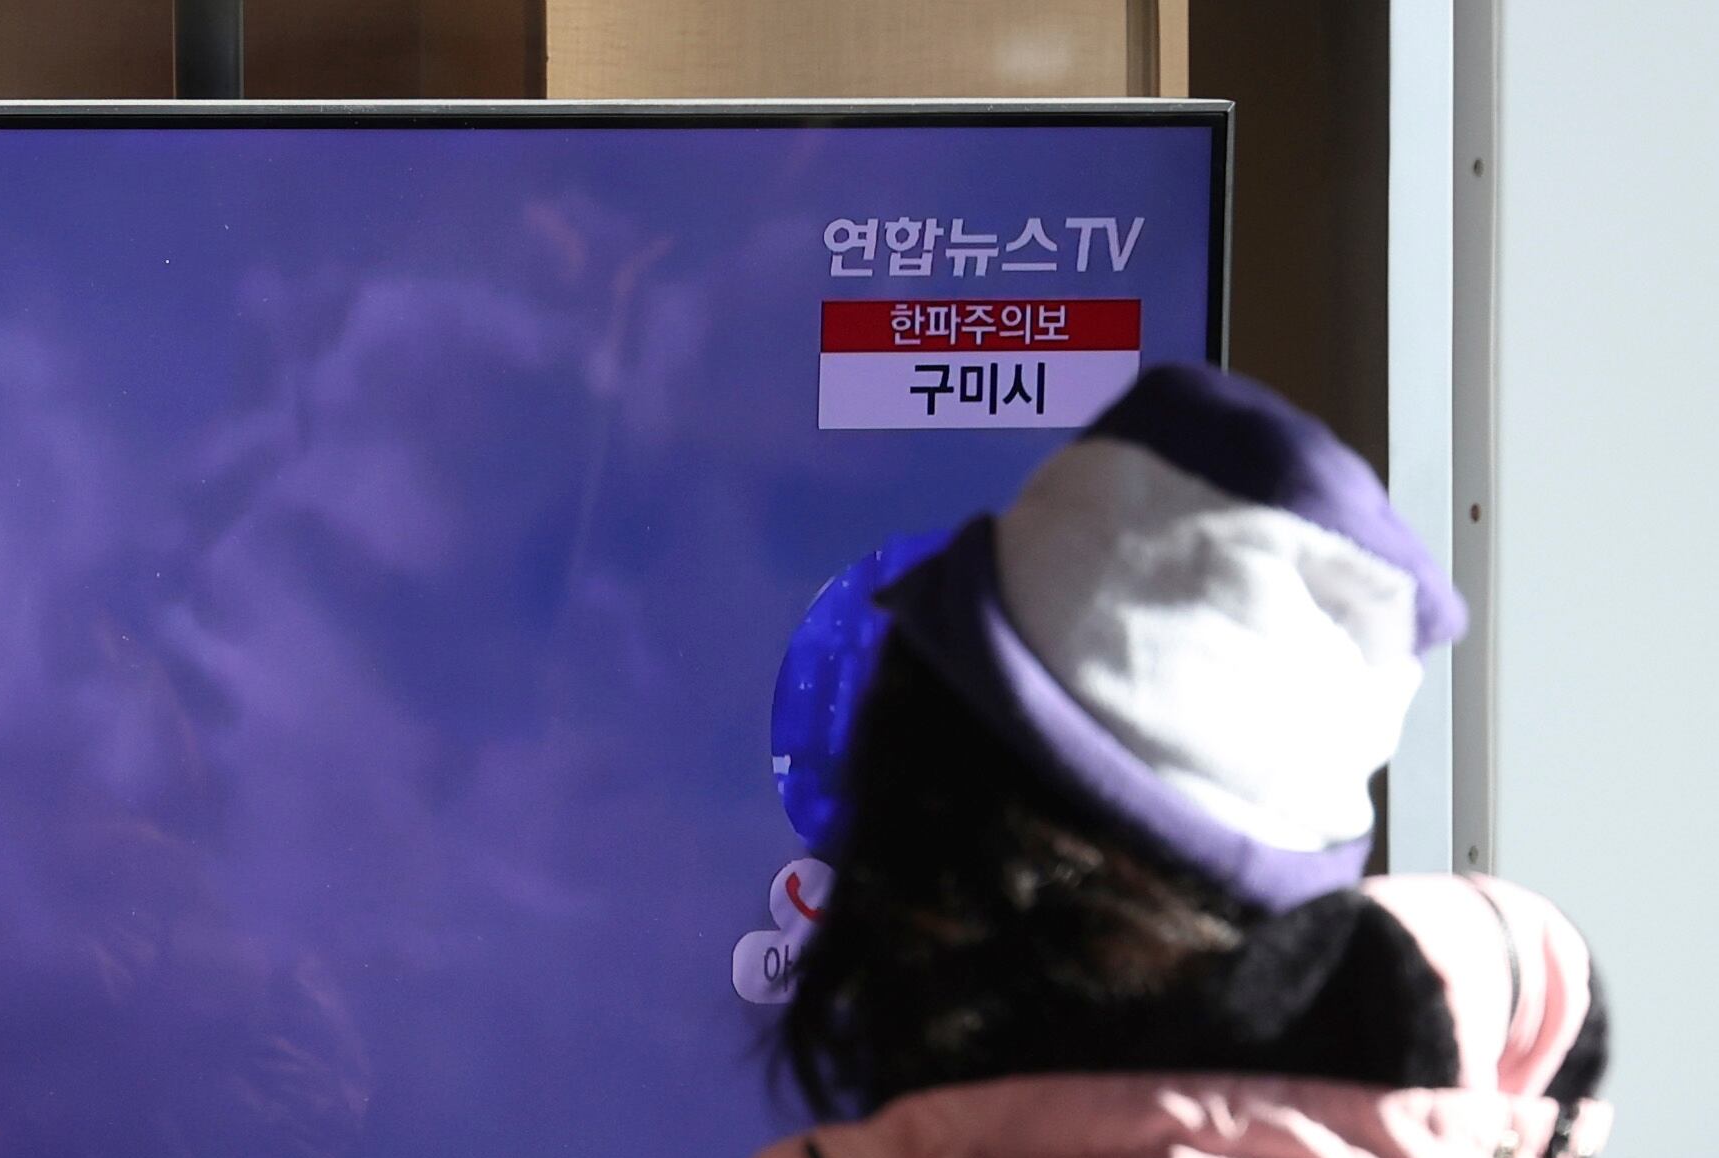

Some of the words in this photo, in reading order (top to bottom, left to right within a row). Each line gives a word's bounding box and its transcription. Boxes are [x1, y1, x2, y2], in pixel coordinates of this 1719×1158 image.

[822, 216, 1146, 278] 연합뉴스TV
[889, 303, 1070, 346] 한파주의보
[909, 361, 1047, 416] 구미시
